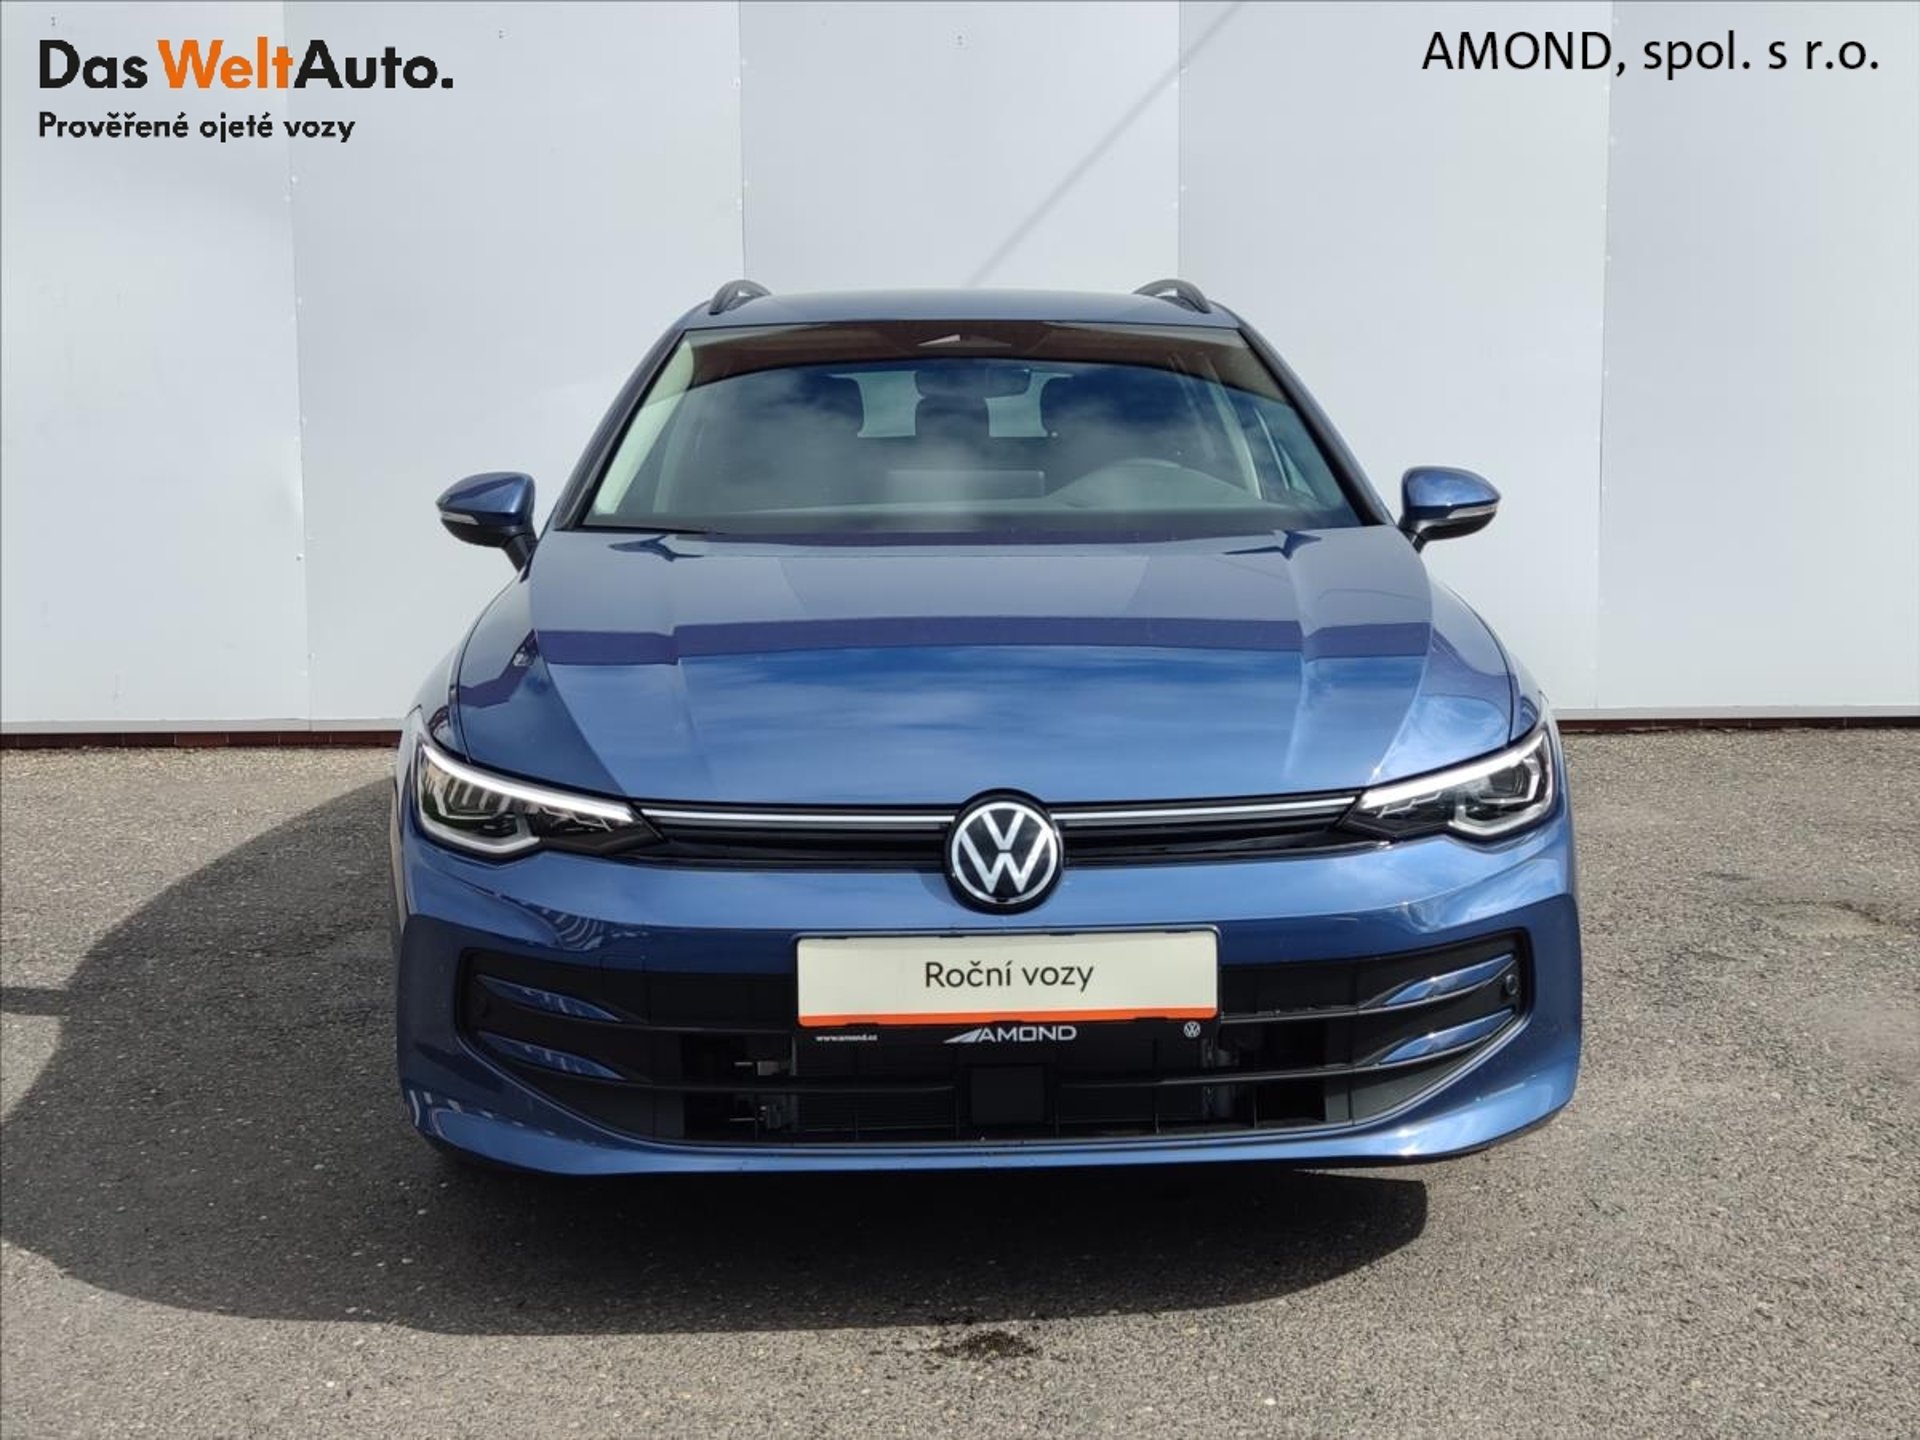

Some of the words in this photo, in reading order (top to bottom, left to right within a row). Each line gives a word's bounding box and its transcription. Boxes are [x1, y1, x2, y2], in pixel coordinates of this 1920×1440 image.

[925, 960, 1013, 988] Roční
[1021, 965, 1094, 992] vozy
[977, 1025, 1078, 1043] AMOND
